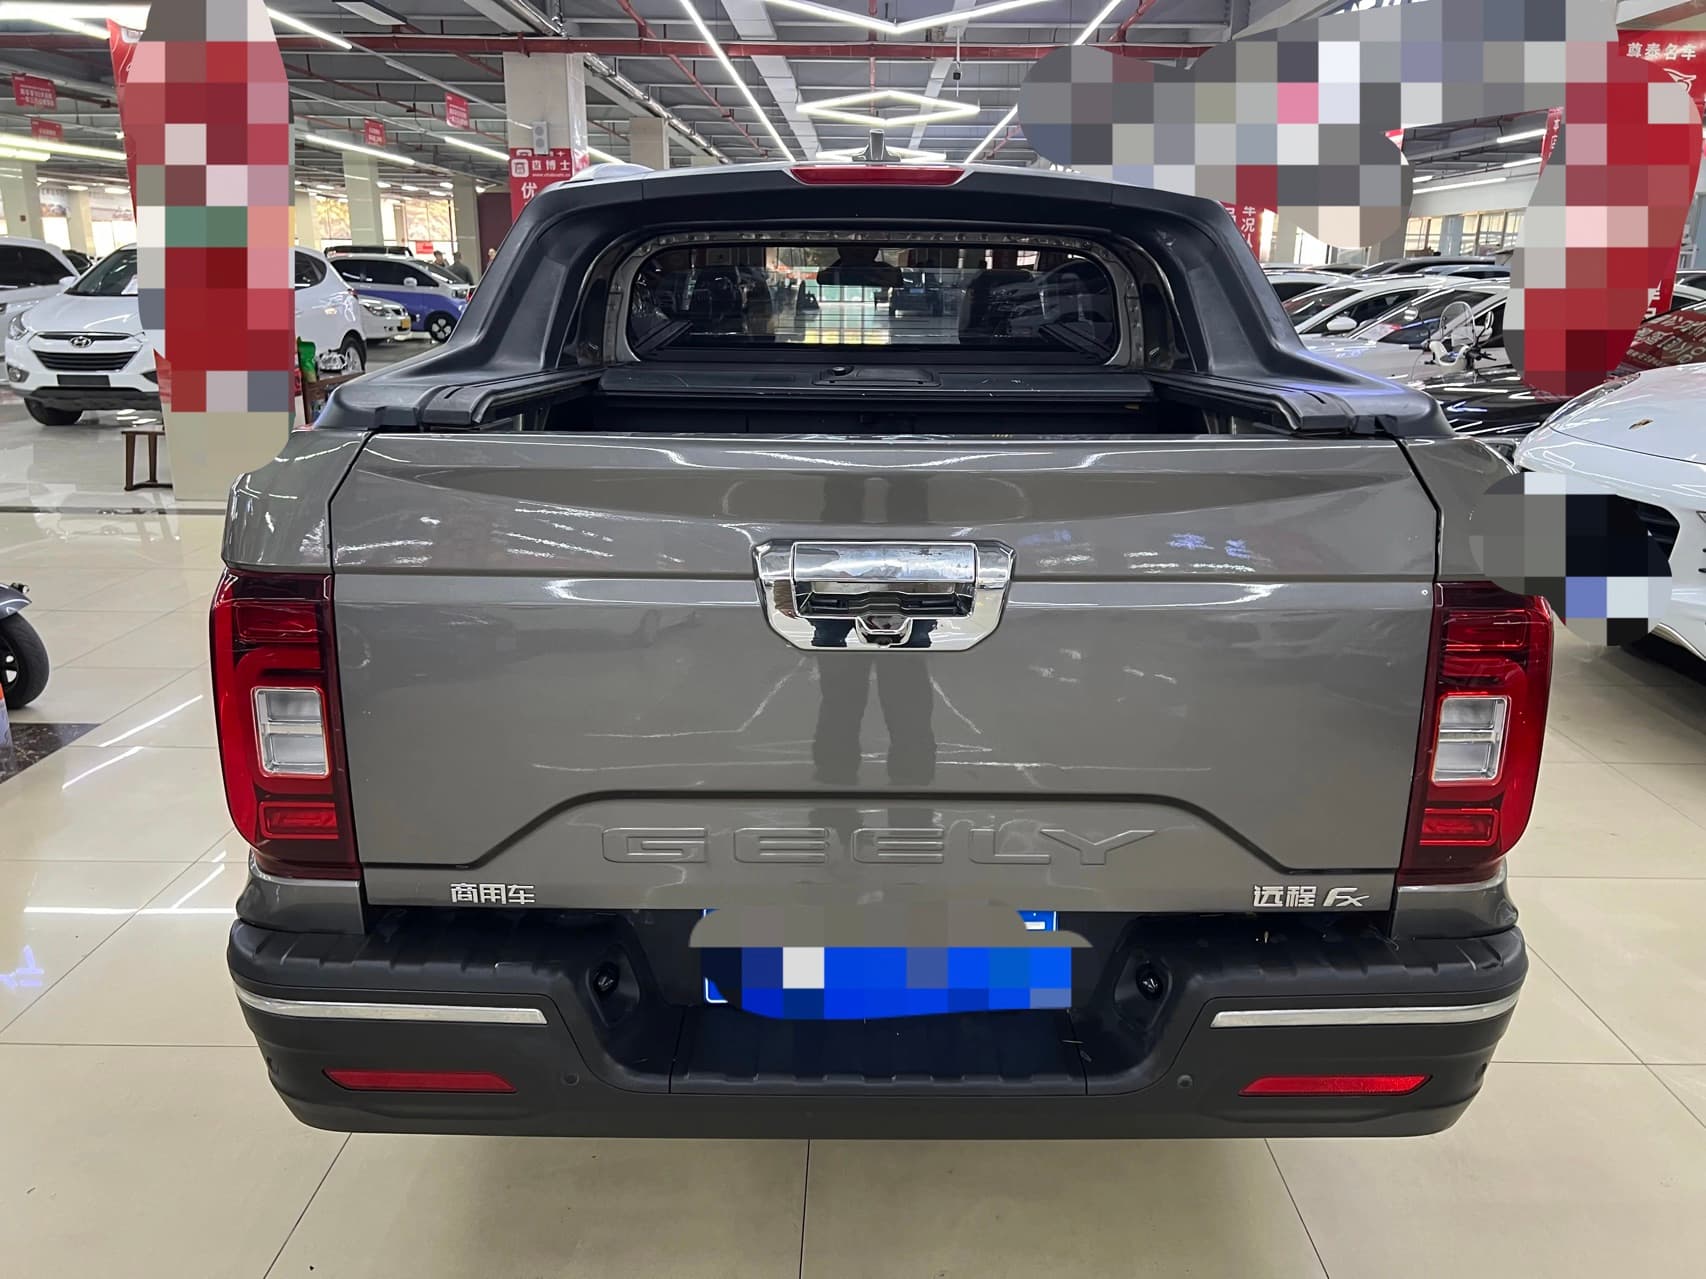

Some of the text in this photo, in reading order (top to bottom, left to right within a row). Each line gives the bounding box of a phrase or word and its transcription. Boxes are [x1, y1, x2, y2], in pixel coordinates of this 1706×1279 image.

[602, 827, 1156, 865] GEELY
[450, 883, 535, 905] 商用车
[1253, 885, 1317, 907] 远程
